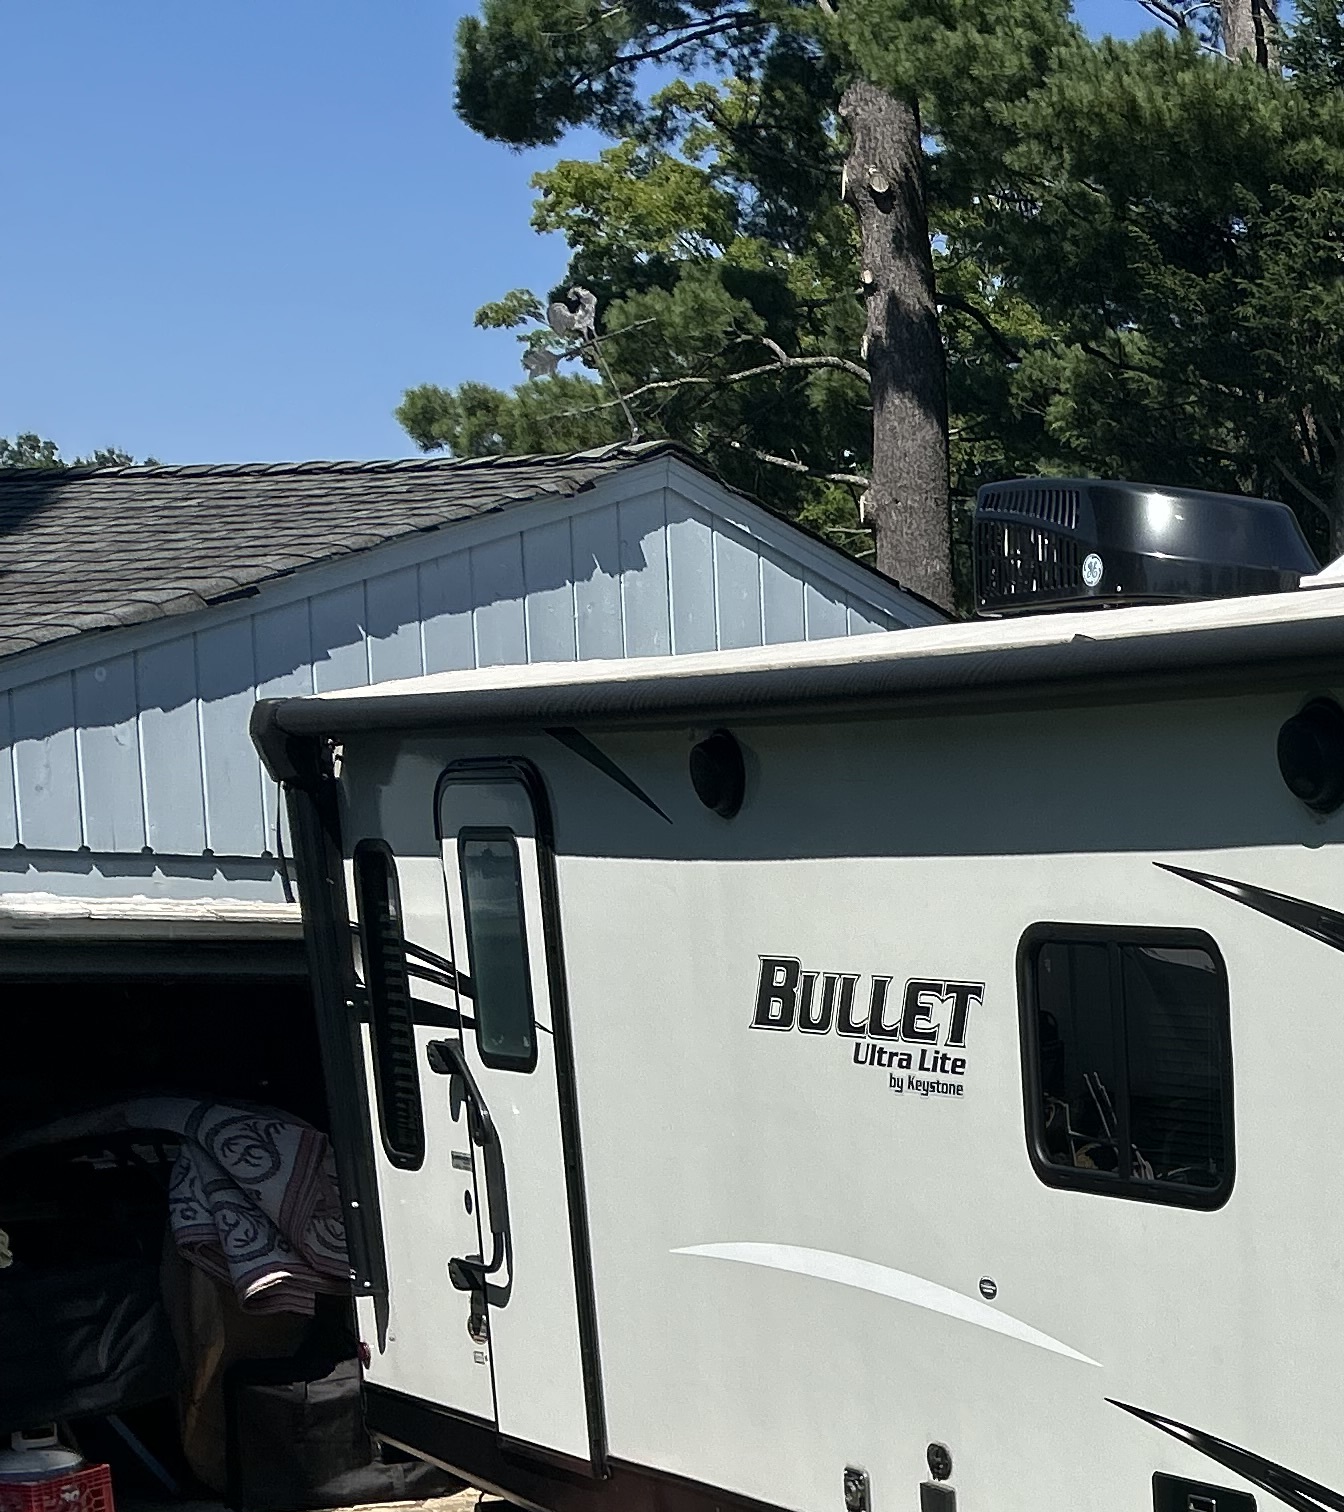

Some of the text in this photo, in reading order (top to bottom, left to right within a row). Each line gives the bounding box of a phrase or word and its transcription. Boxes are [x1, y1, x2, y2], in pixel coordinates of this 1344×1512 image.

[749, 954, 986, 1048] BULLET
[853, 1042, 967, 1075] Ultra Lite
[889, 1072, 964, 1096] by Keystone
